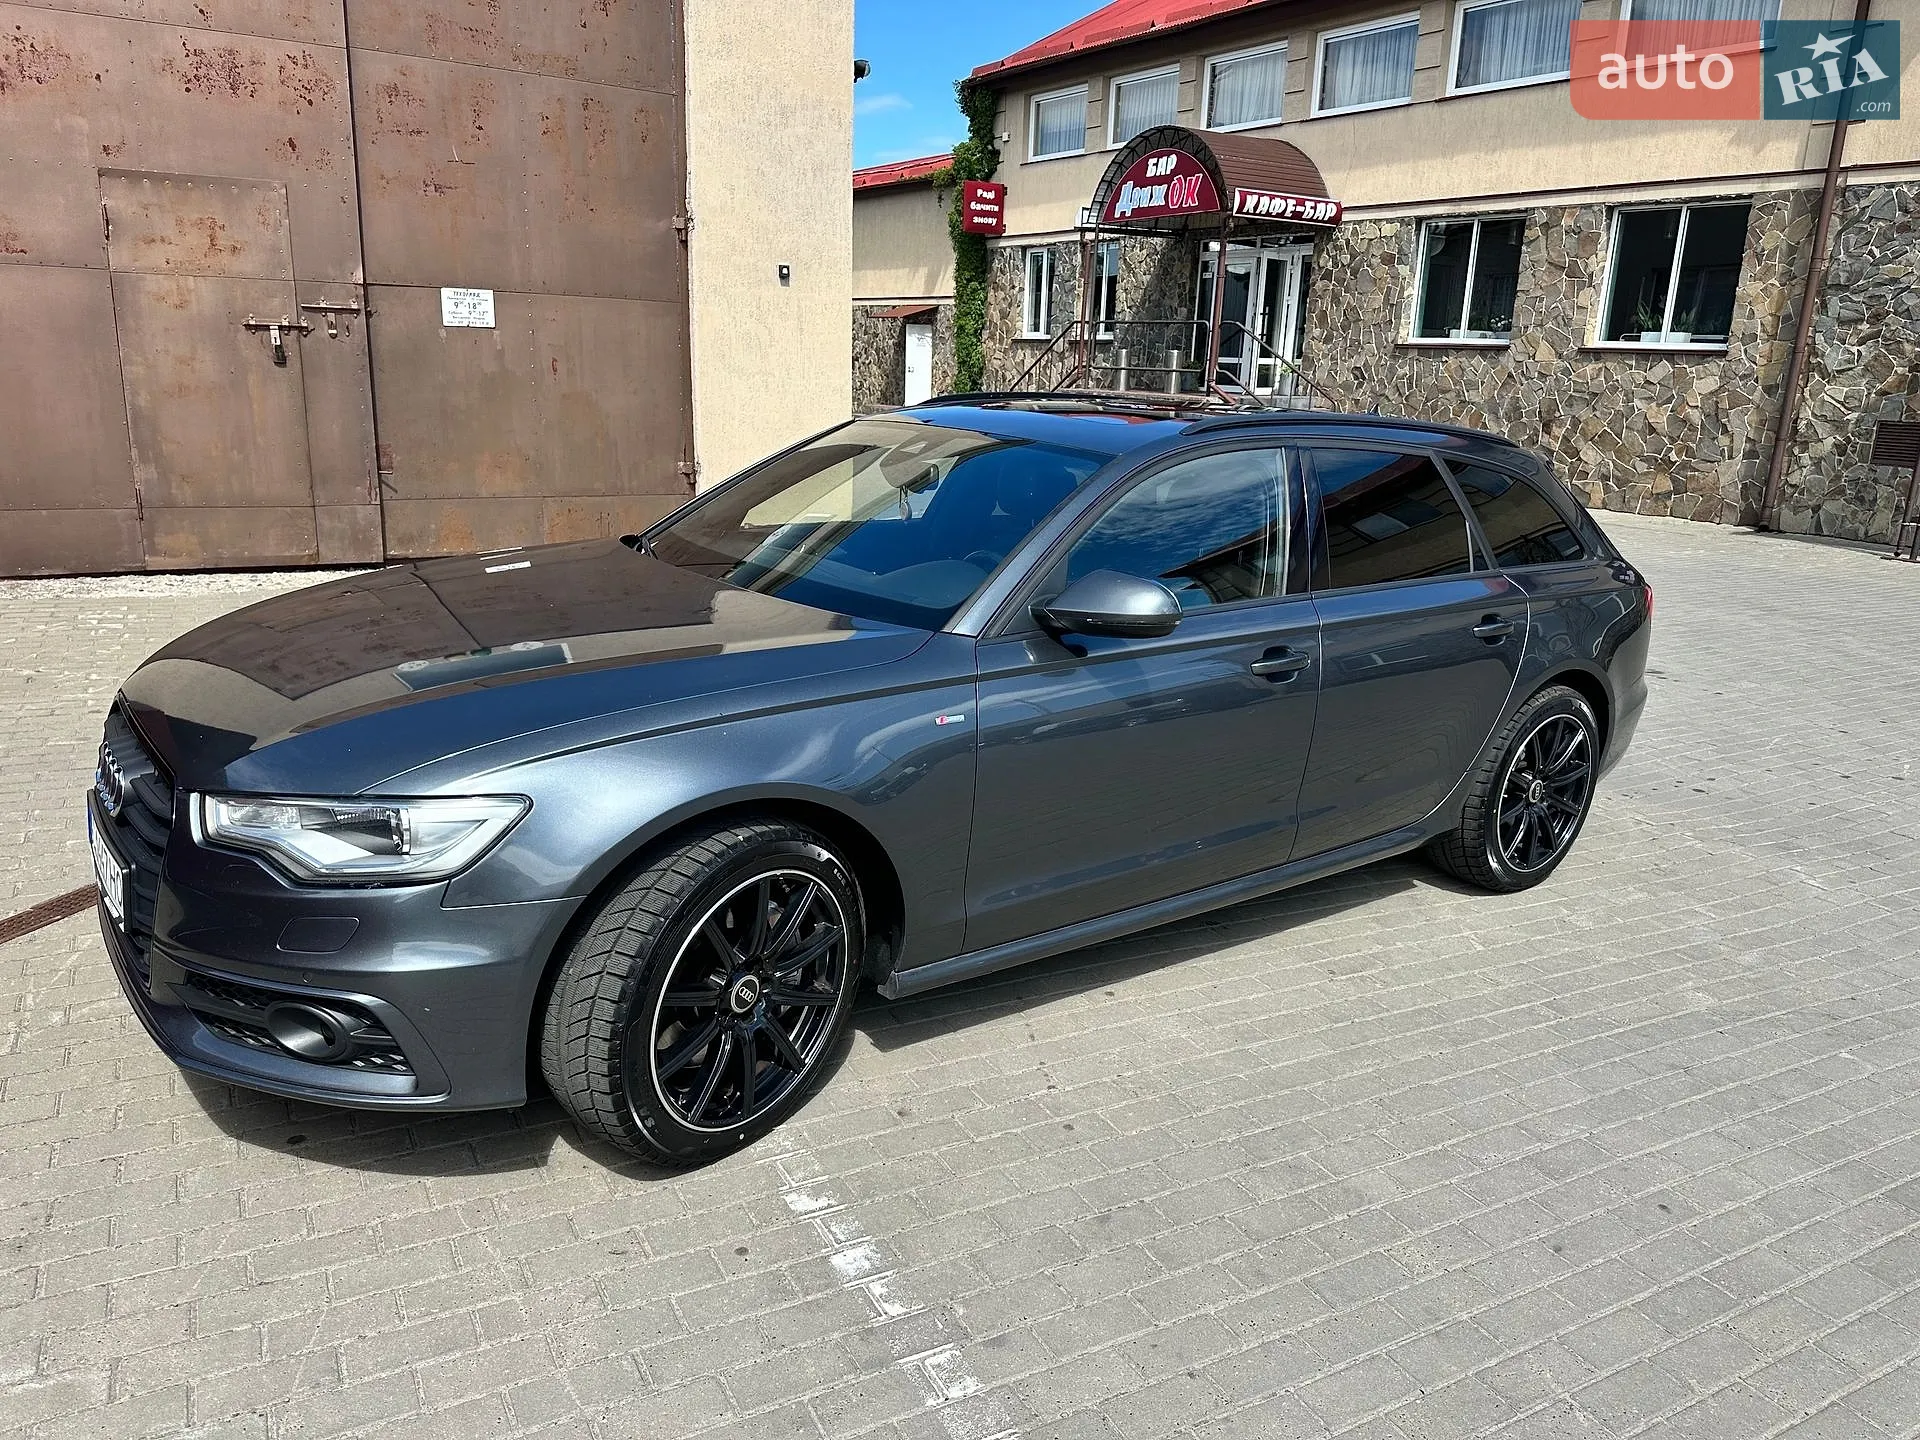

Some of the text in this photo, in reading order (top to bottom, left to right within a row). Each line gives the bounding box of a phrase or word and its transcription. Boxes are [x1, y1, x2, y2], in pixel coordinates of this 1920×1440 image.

[1146, 154, 1178, 178] БАР
[1242, 194, 1338, 221] КАФЕ-БАР
[972, 215, 998, 226] знову
